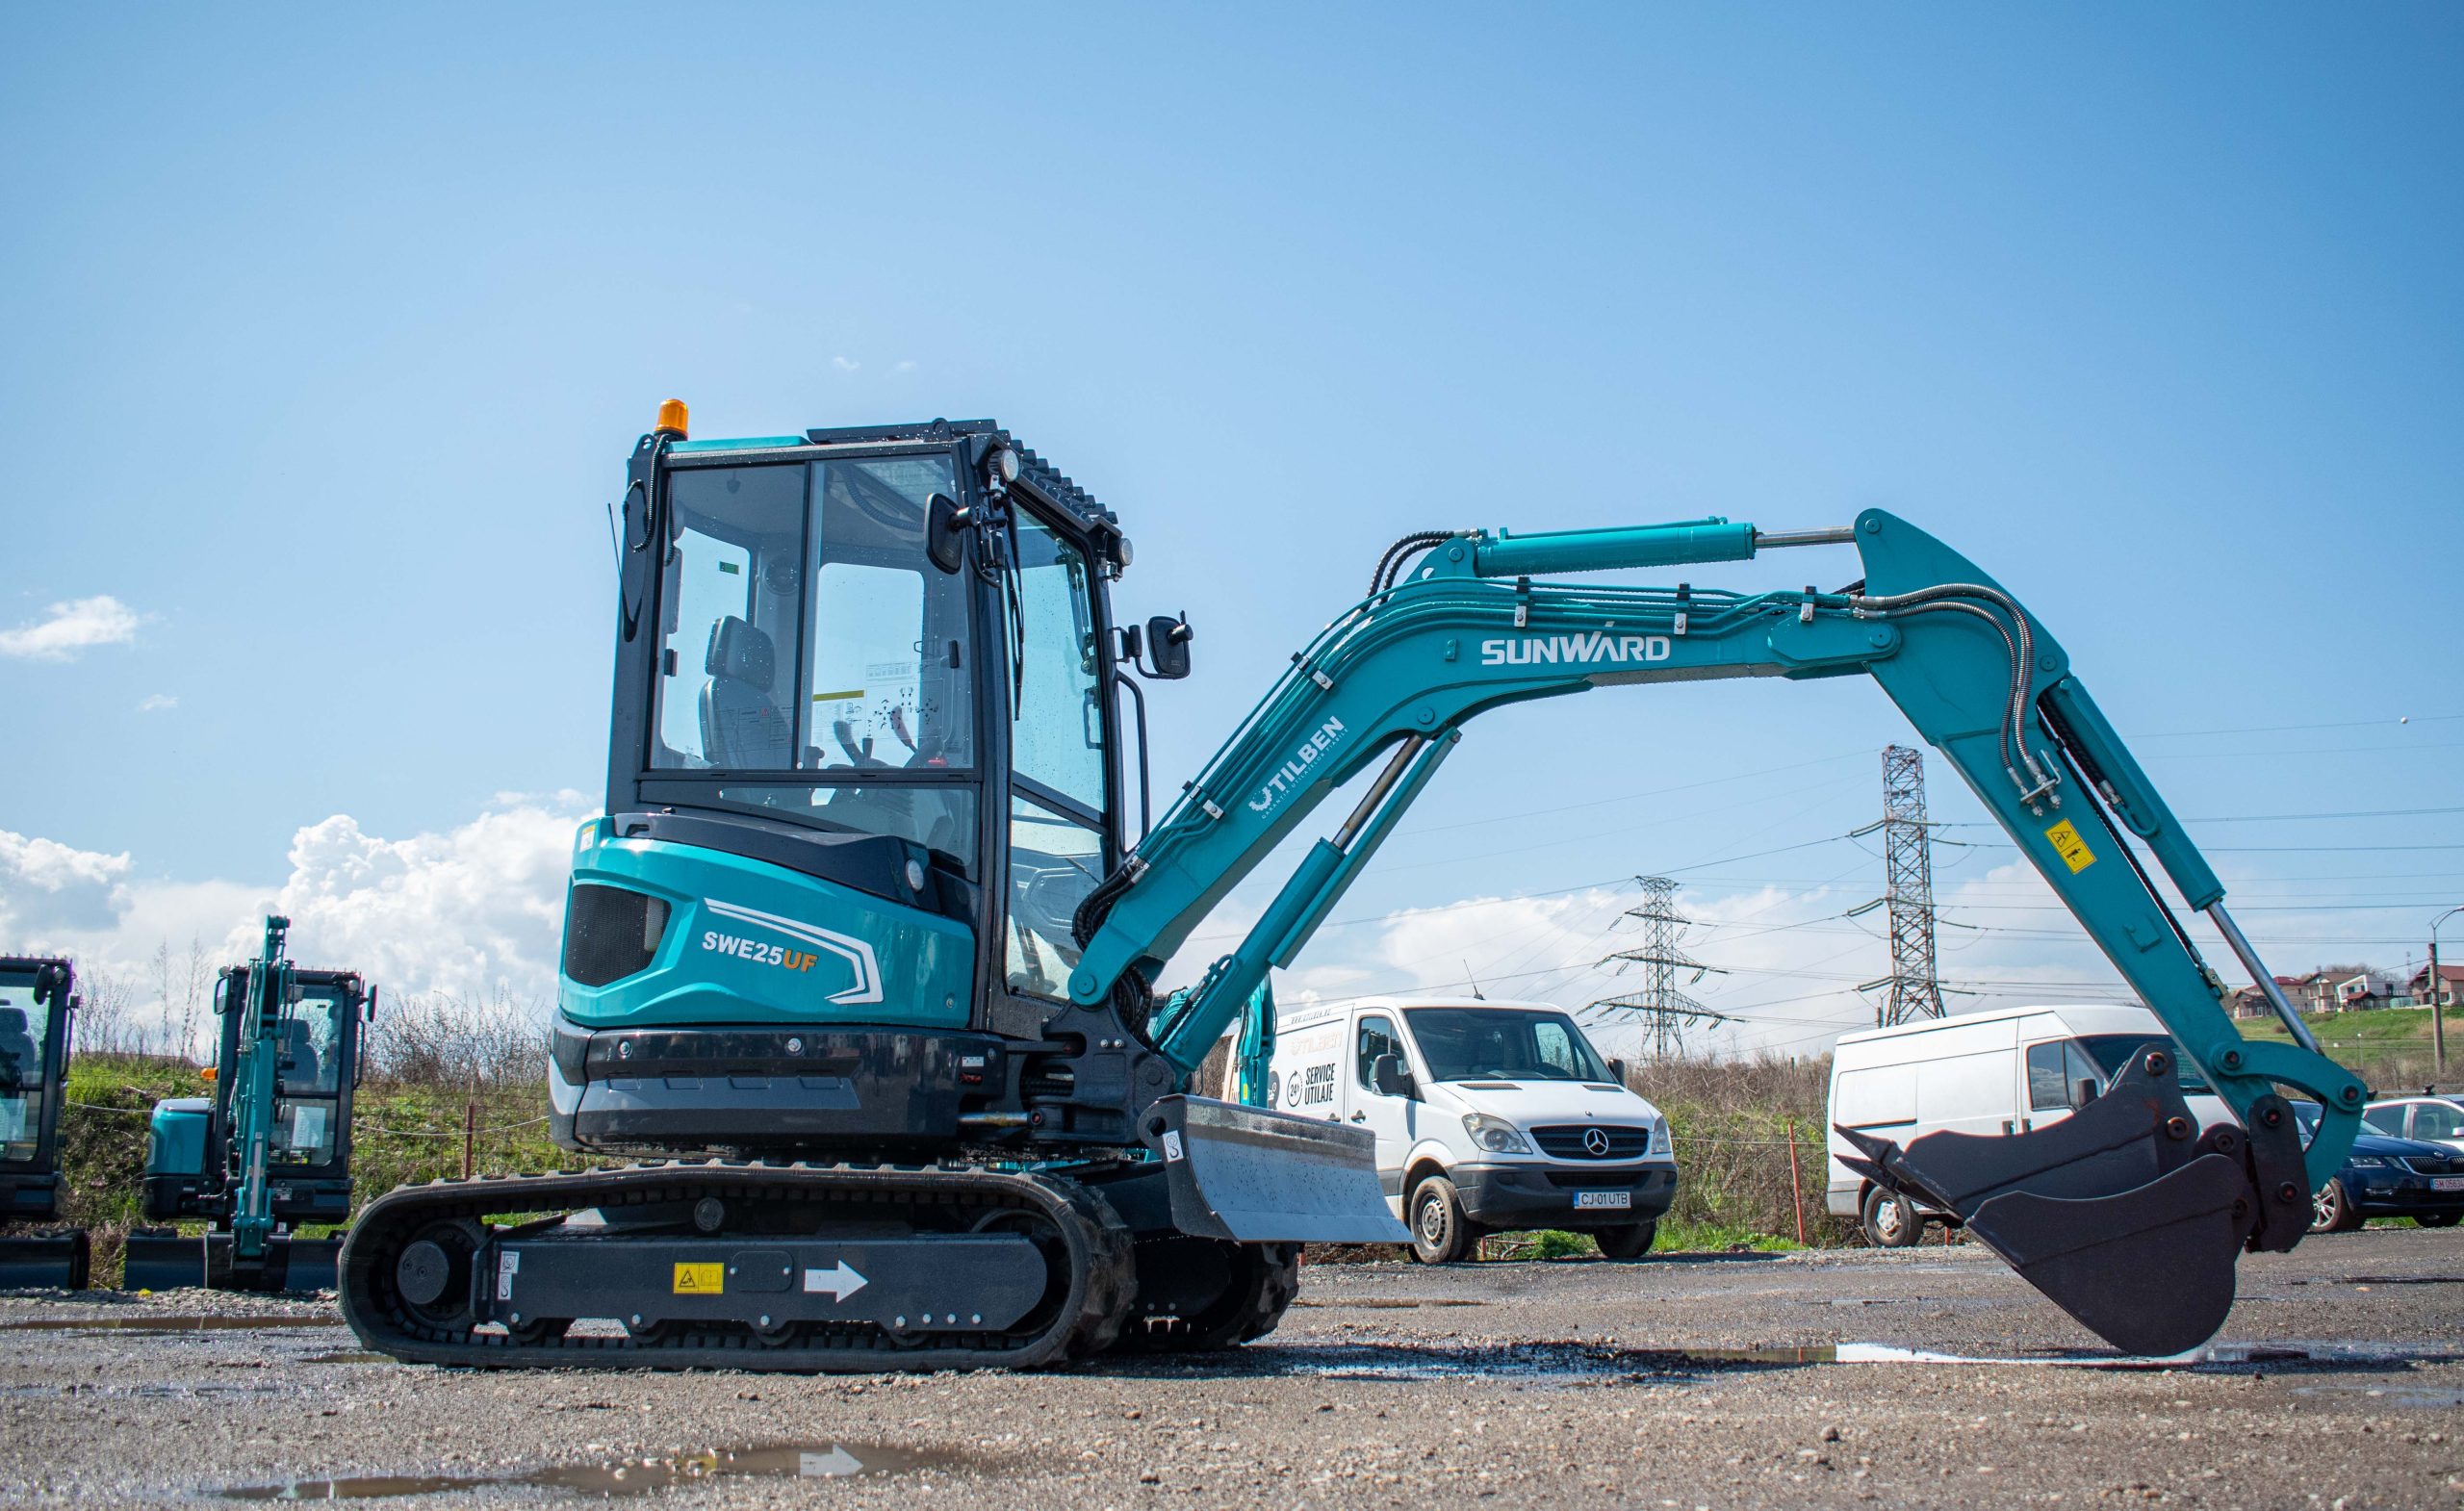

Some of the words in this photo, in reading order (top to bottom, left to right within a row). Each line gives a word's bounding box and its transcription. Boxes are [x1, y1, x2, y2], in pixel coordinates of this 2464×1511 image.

[1481, 630, 1671, 665] SUNWARD
[1248, 715, 1345, 811] UTILBEN
[702, 931, 819, 973] SWE25UF
[1305, 1063, 1336, 1086] SERVICE
[1304, 1083, 1334, 1106] UTILAJE
[1581, 1193, 1594, 1205] CJ
[1598, 1193, 1607, 1205] 01
[1608, 1192, 1628, 1204] UTB
